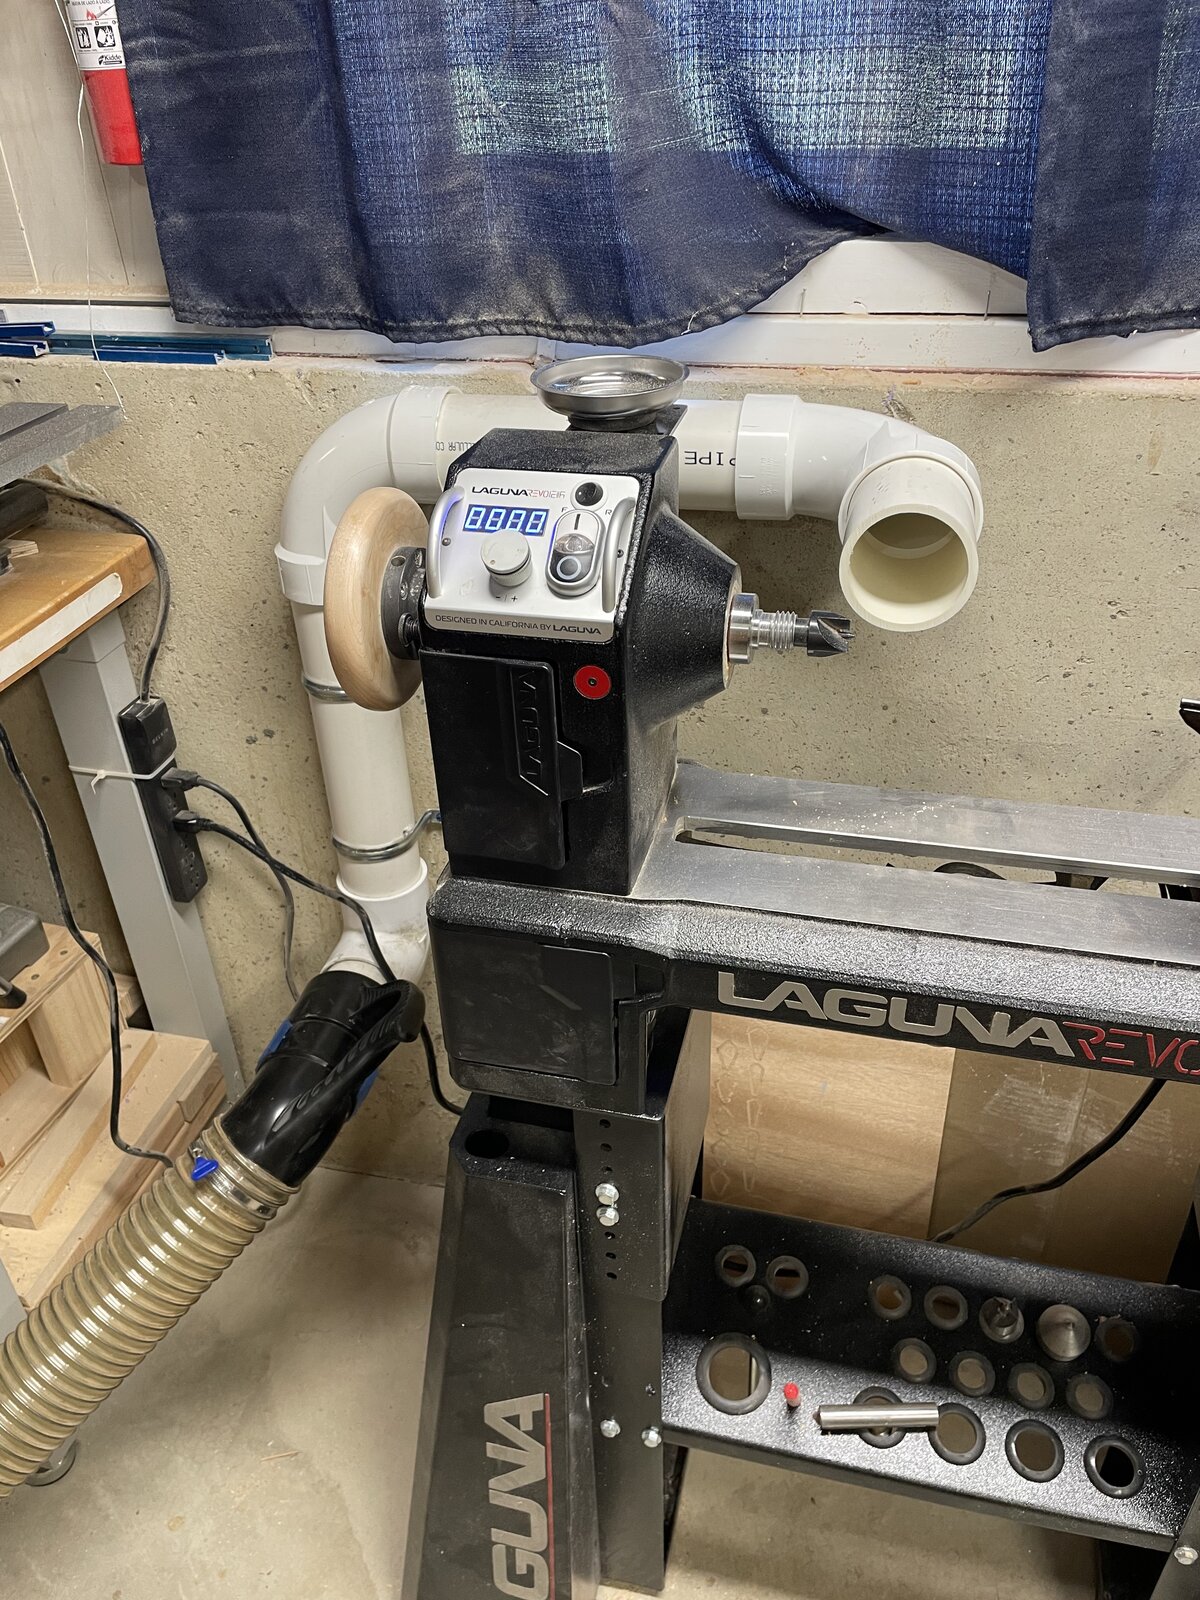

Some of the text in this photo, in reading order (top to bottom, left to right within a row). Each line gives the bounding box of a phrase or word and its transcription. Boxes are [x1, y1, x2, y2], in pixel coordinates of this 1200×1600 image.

[448, 442, 475, 452] LULAR
[471, 486, 529, 497] LAGUNA
[435, 614, 602, 635] DESIGNED IN CALIFORNIA BY LAGUNA
[717, 971, 1076, 1058] LAGUNA
